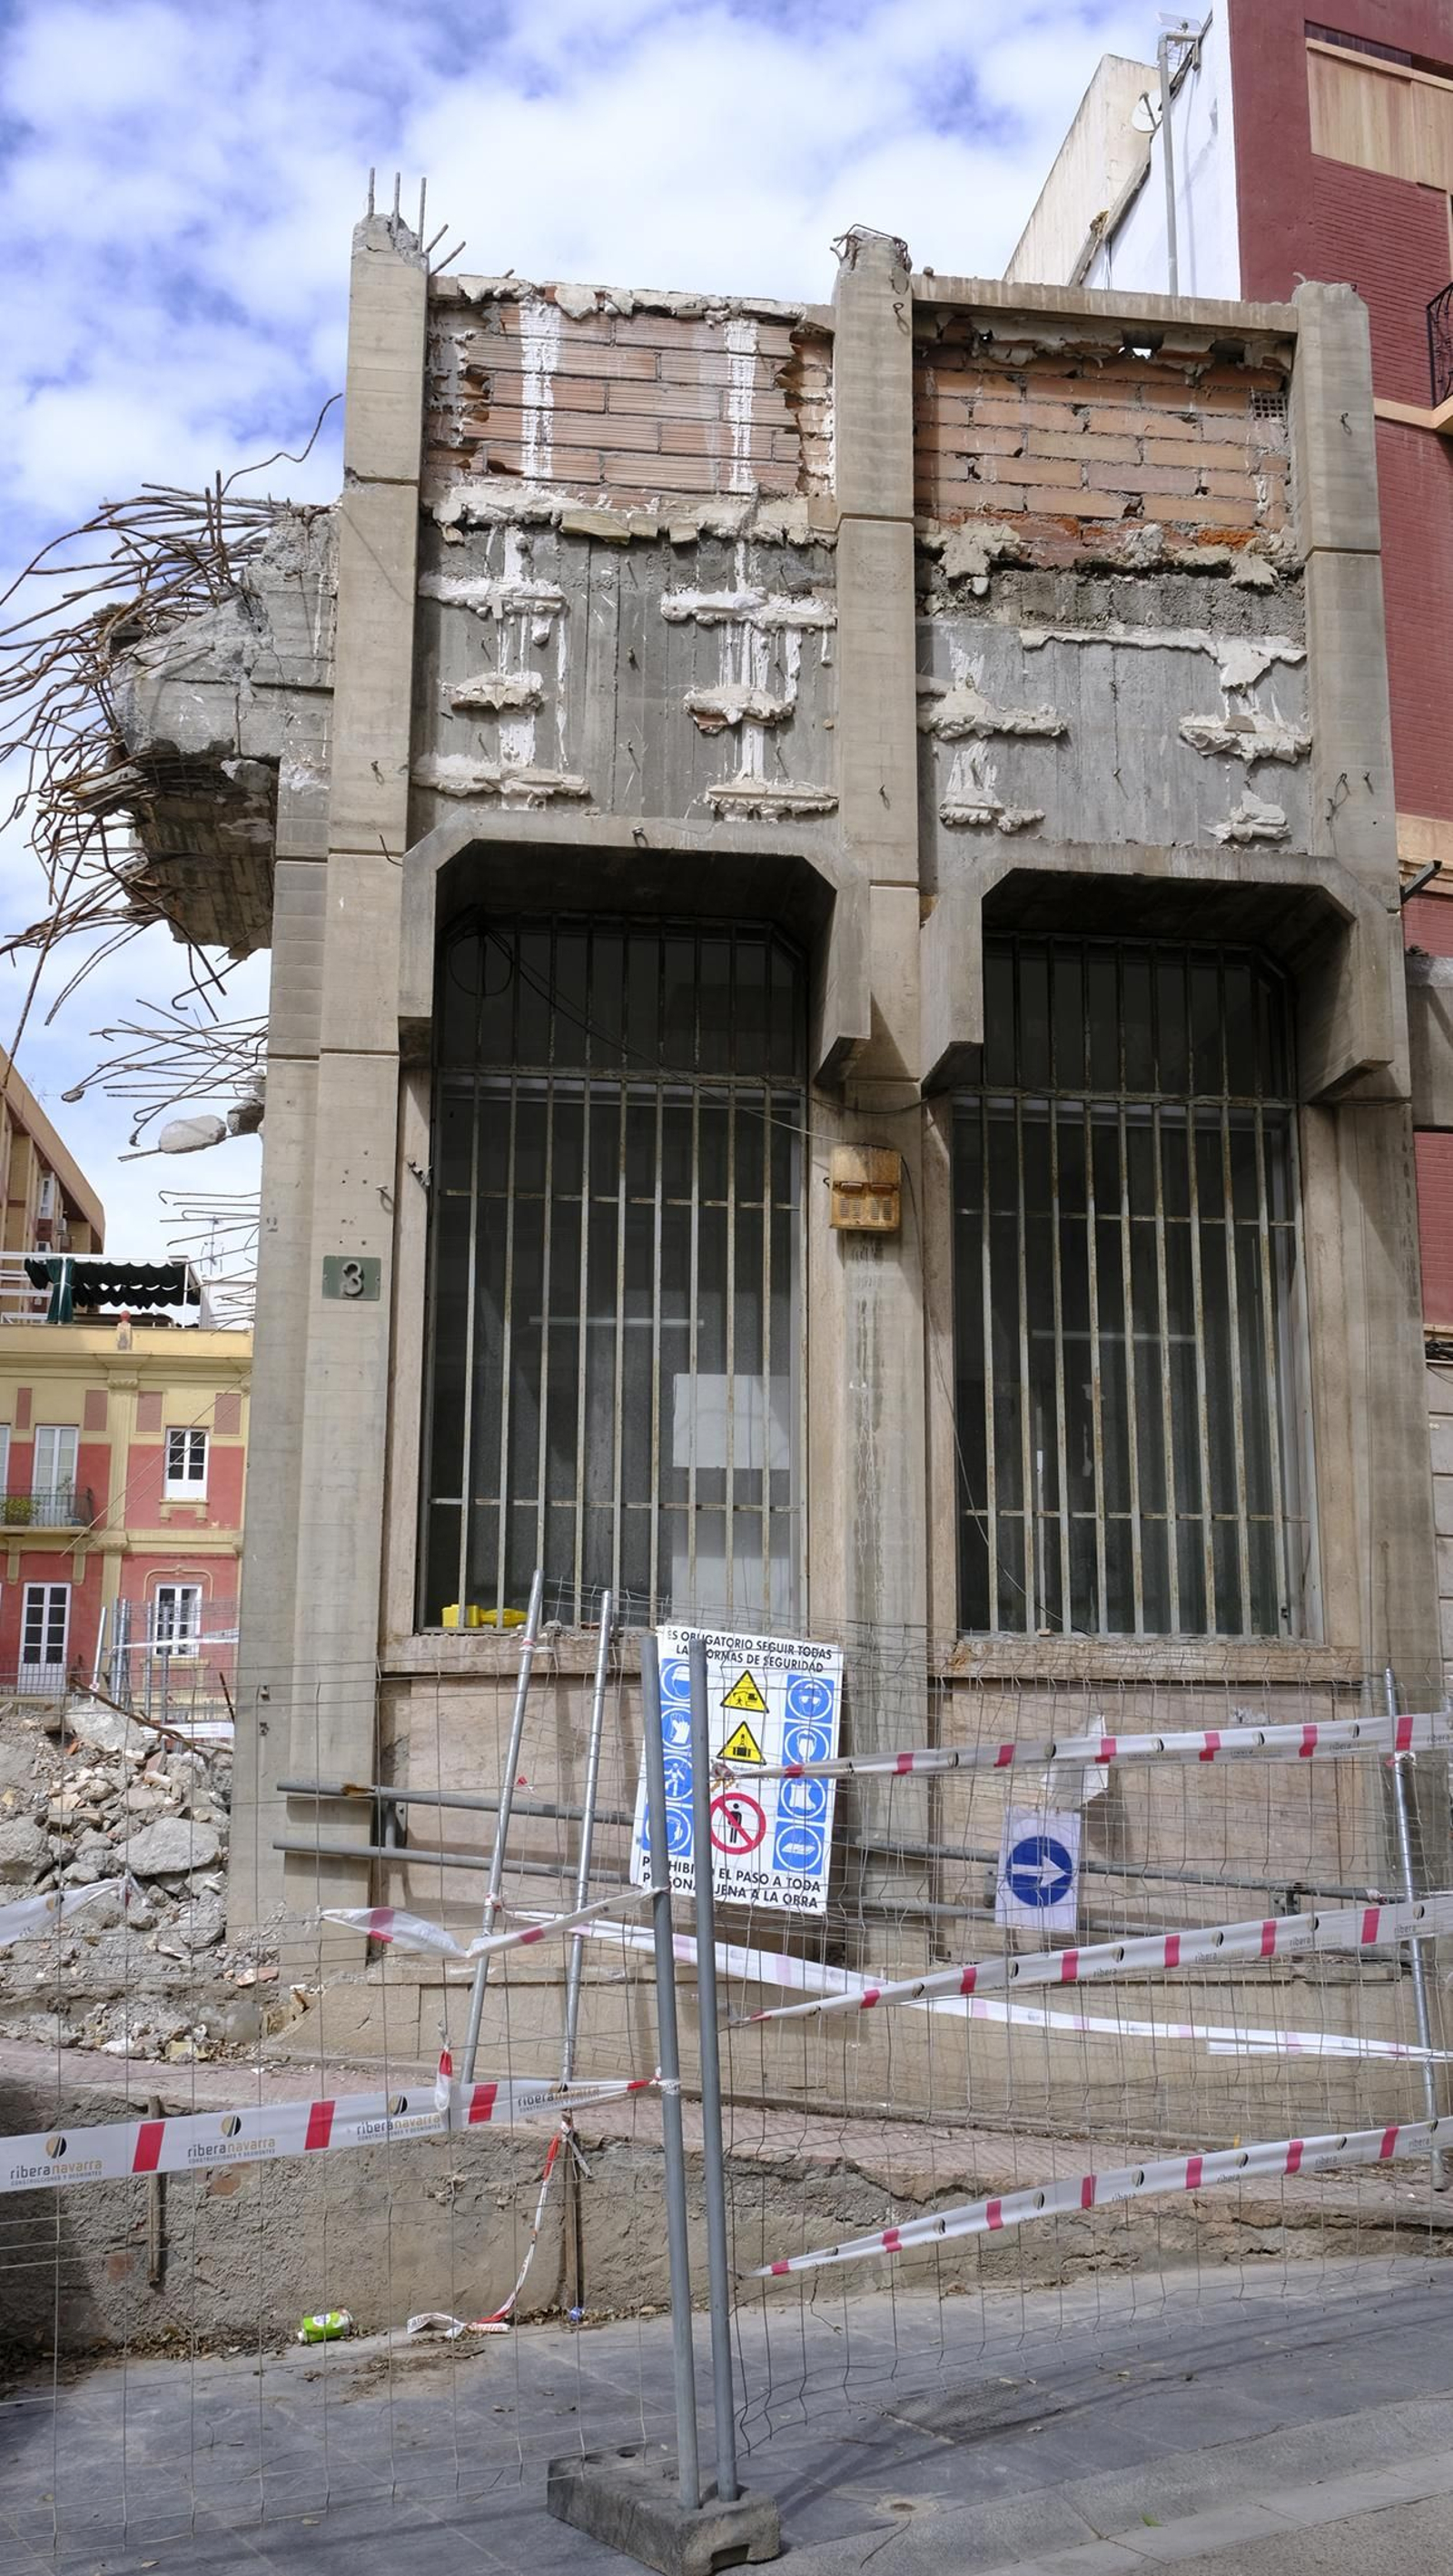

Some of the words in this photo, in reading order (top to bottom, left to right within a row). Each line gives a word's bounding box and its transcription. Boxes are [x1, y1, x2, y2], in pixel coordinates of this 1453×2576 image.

[341, 1260, 363, 1297] 3
[706, 1649, 743, 1663] ORMAS
[746, 1653, 760, 1665] DE
[764, 1656, 824, 1673] SEGURIDAD
[756, 1640, 795, 1654] SEGUIR
[797, 1645, 832, 1660] TODAS
[718, 1868, 732, 1880] EL
[736, 1870, 769, 1885] PASO
[773, 1876, 781, 1887] A
[786, 1877, 821, 1892] TODA
[715, 1884, 746, 1898] JENA
[751, 1890, 759, 1900] A
[764, 1890, 778, 1902] LA
[783, 1893, 817, 1909] OBRA
